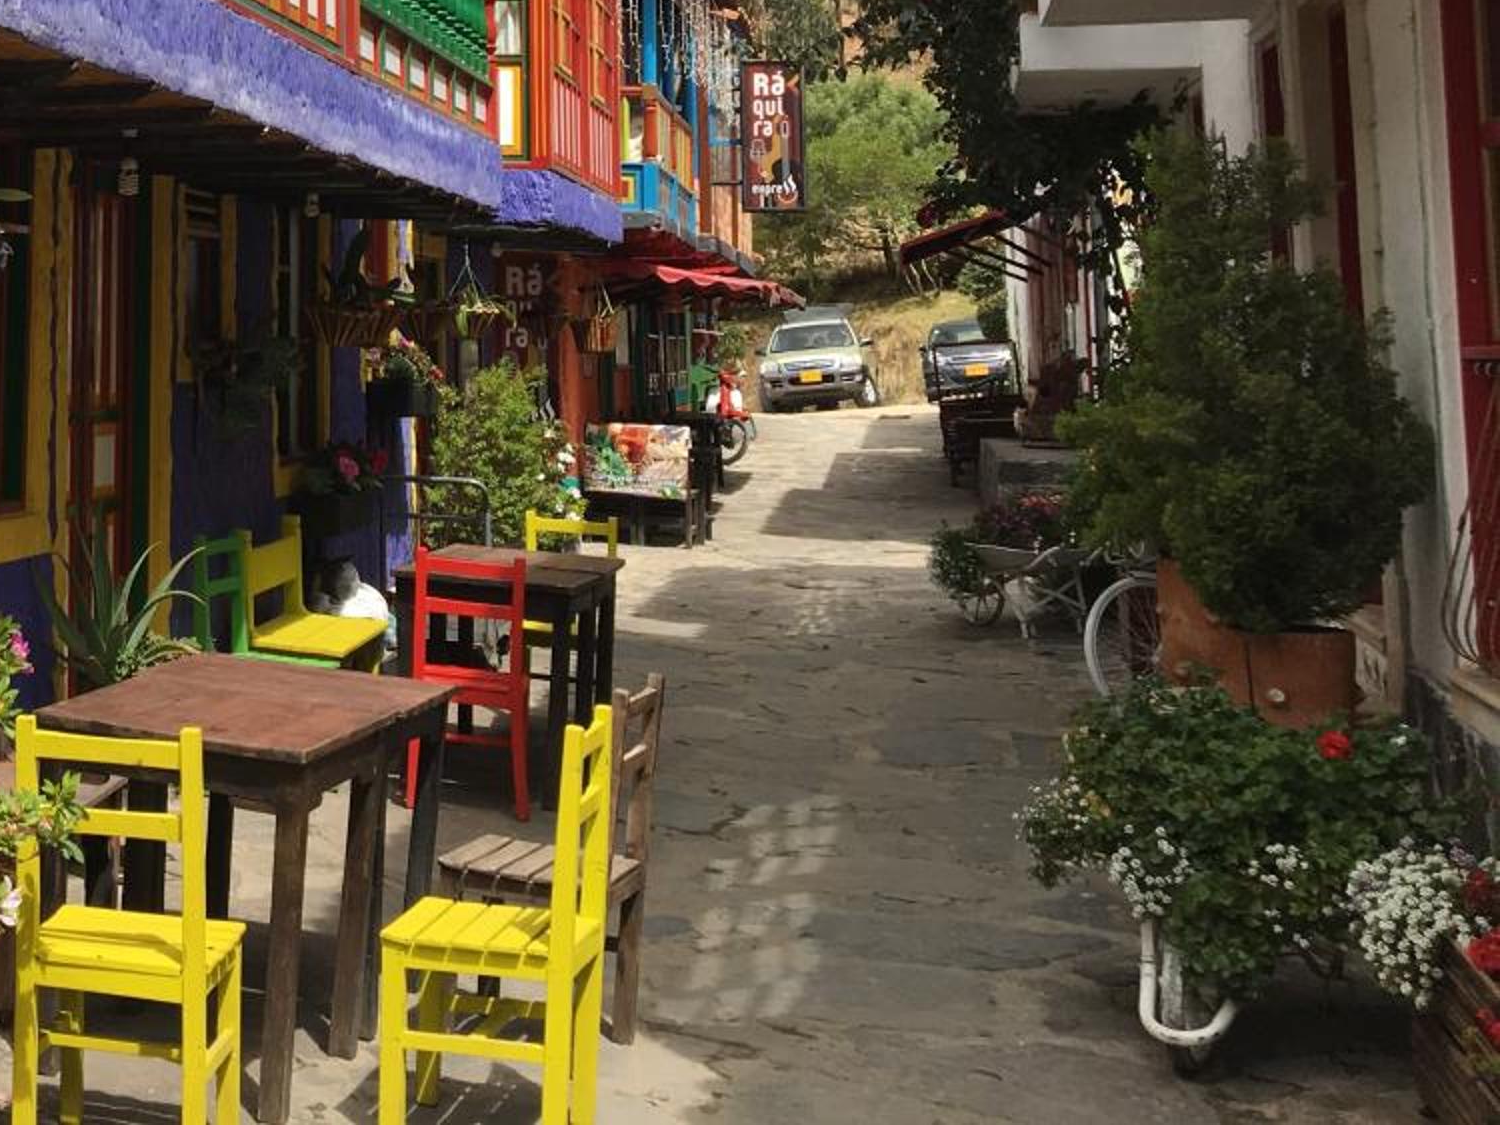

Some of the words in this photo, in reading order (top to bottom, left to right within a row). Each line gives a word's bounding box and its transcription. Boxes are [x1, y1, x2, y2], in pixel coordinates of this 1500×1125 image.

[753, 71, 785, 96] Rá
[753, 97, 784, 119] qui
[753, 121, 773, 137] ra
[505, 263, 543, 296] Rá
[505, 327, 529, 348] ra
